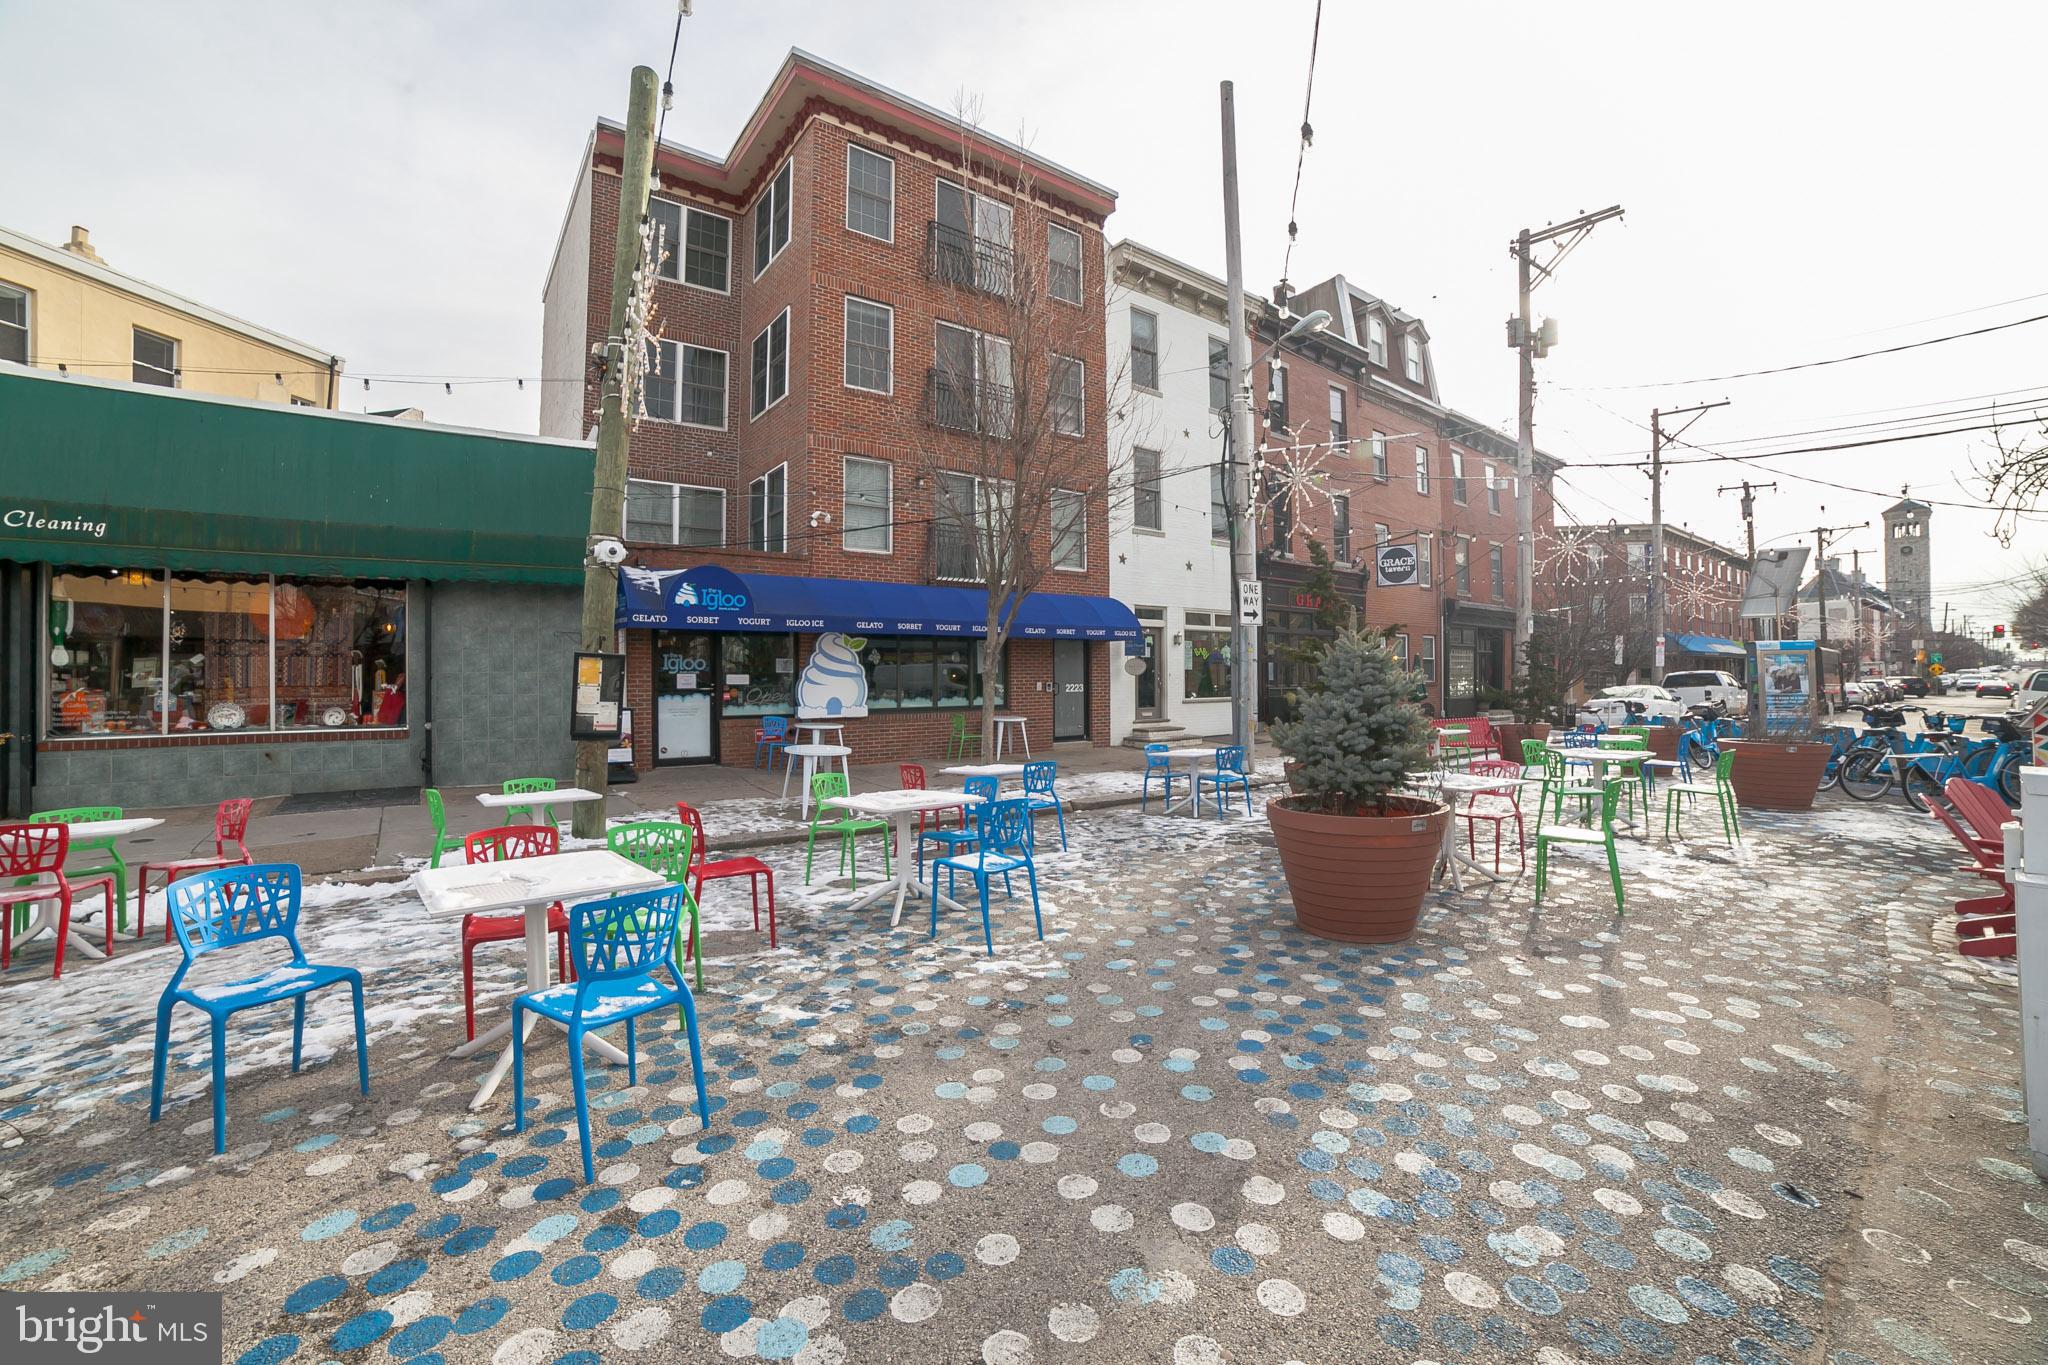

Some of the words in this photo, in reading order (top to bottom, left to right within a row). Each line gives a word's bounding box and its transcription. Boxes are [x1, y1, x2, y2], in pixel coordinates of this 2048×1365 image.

[3, 509, 107, 538] Cleaning
[1379, 557, 1415, 568] GRACE
[1243, 584, 1259, 595] ONE
[701, 588, 747, 611] Igloo
[1243, 596, 1260, 607] WAY
[632, 614, 668, 623] GELATO
[686, 616, 720, 625] SORBET
[737, 617, 772, 626] YOGURT
[786, 619, 811, 627] IGLOO
[811, 620, 825, 628] ICE
[856, 621, 884, 630] GELATO
[897, 622, 923, 631] SORBET
[935, 623, 961, 632] YOGURT
[1024, 627, 1047, 635] GELATO
[1056, 628, 1076, 636] SORBET
[1086, 629, 1106, 637] YOGURT
[662, 653, 706, 674] Igloo
[1065, 683, 1084, 693] 2223
